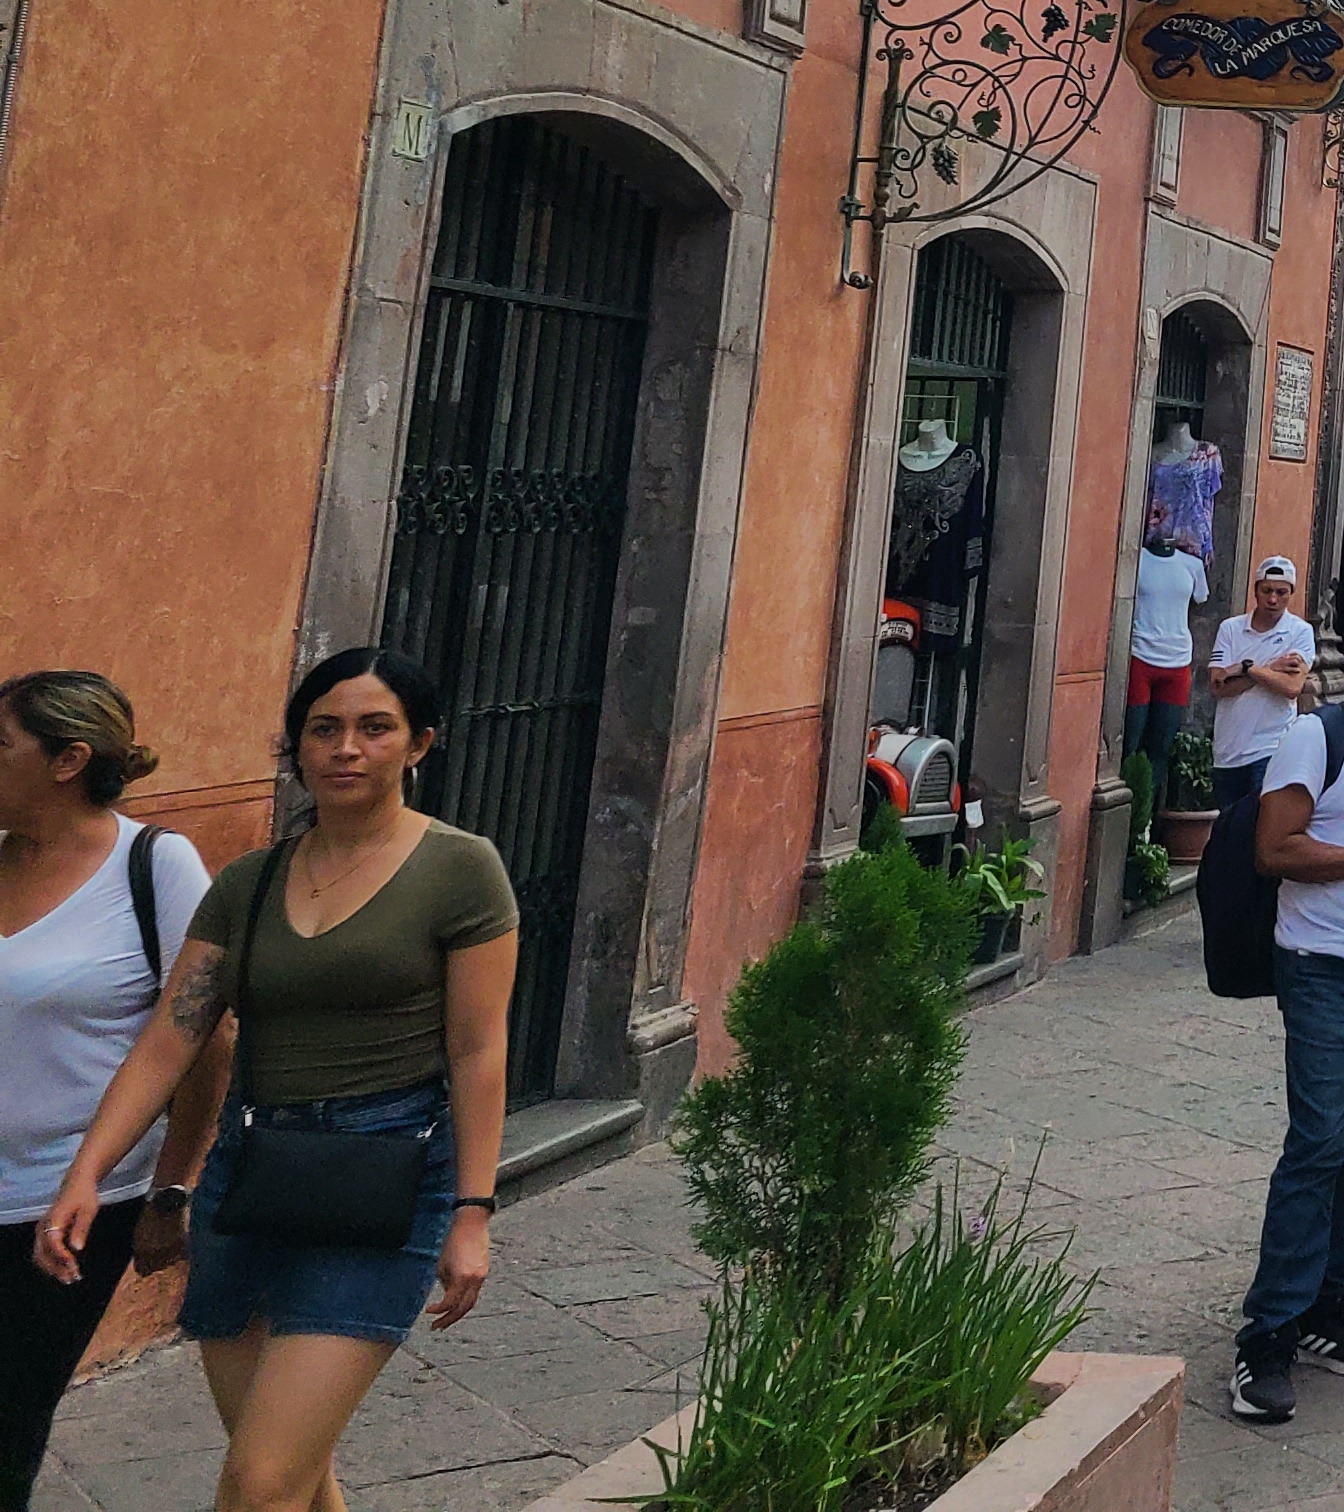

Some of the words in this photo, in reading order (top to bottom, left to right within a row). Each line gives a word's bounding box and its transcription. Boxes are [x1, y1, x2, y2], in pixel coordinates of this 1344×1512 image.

[1162, 17, 1229, 44] COMEDOR
[1222, 37, 1243, 56] DE
[1214, 59, 1239, 75] LA
[1241, 19, 1322, 66] MARQUESA
